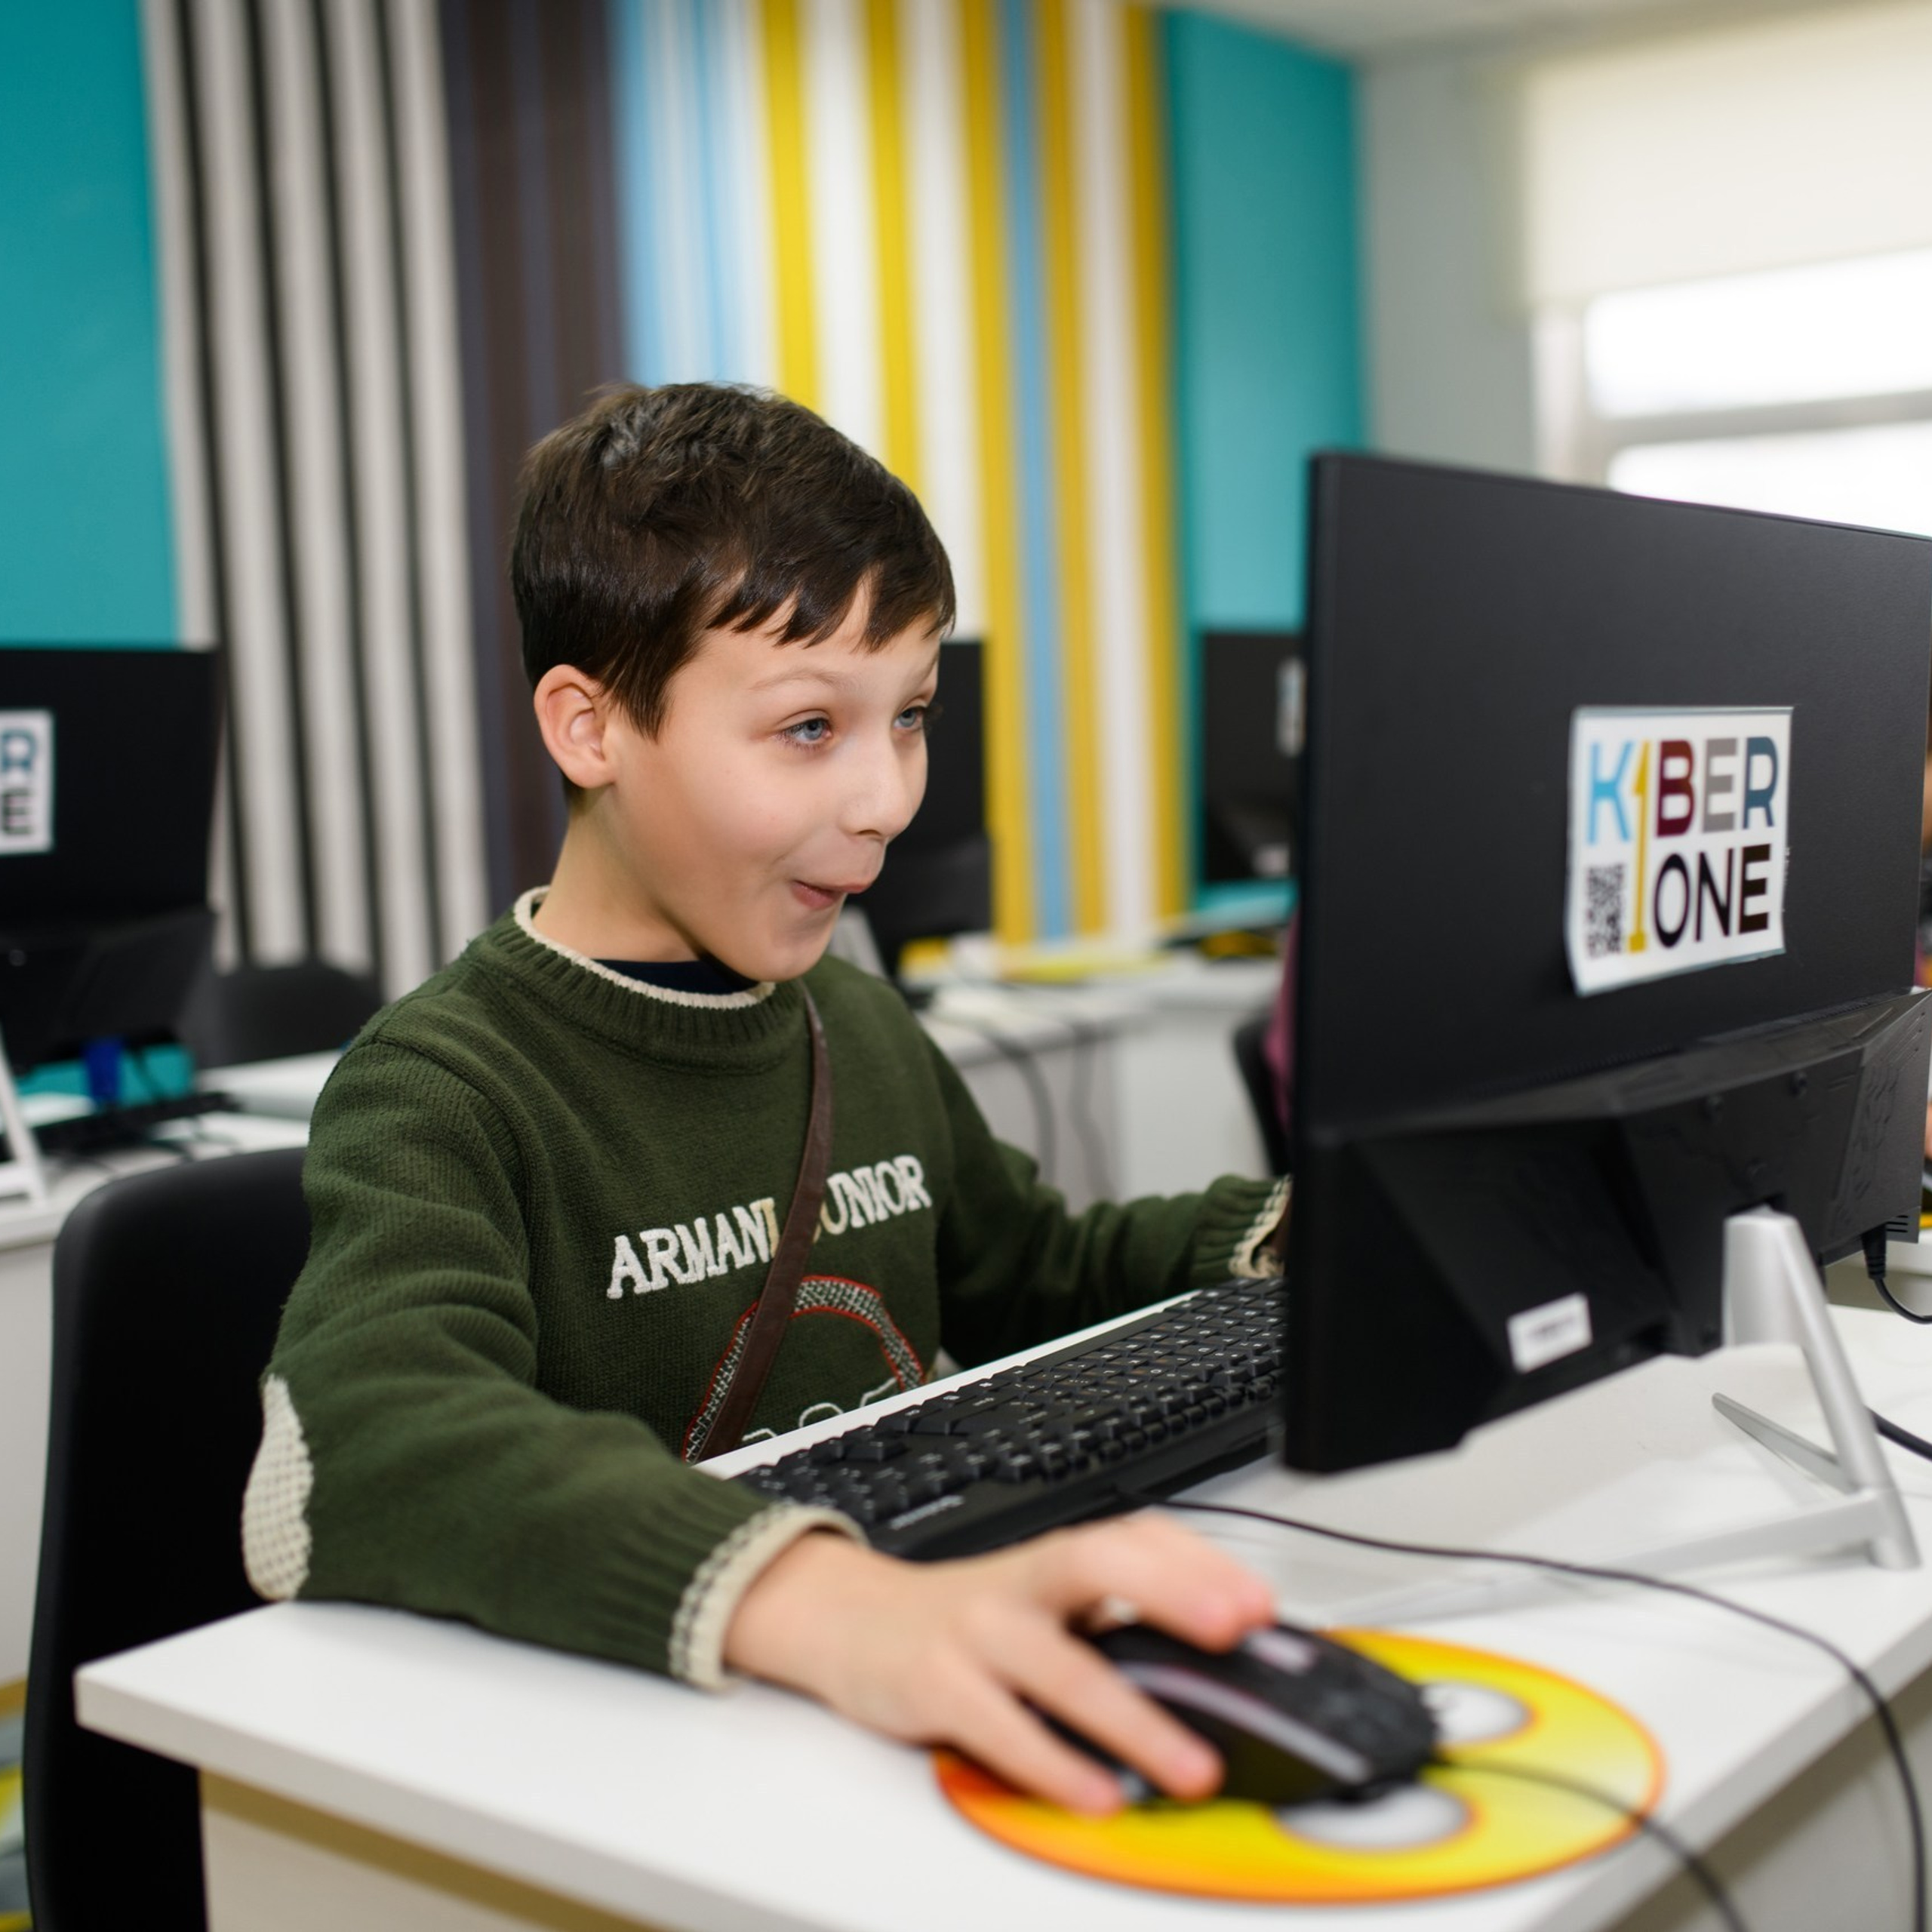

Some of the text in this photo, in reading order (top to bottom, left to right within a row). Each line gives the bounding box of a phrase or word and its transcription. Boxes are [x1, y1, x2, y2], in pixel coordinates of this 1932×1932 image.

[1654, 843, 1771, 949] ONE
[607, 1154, 932, 1299] ARMANI UNIOR
